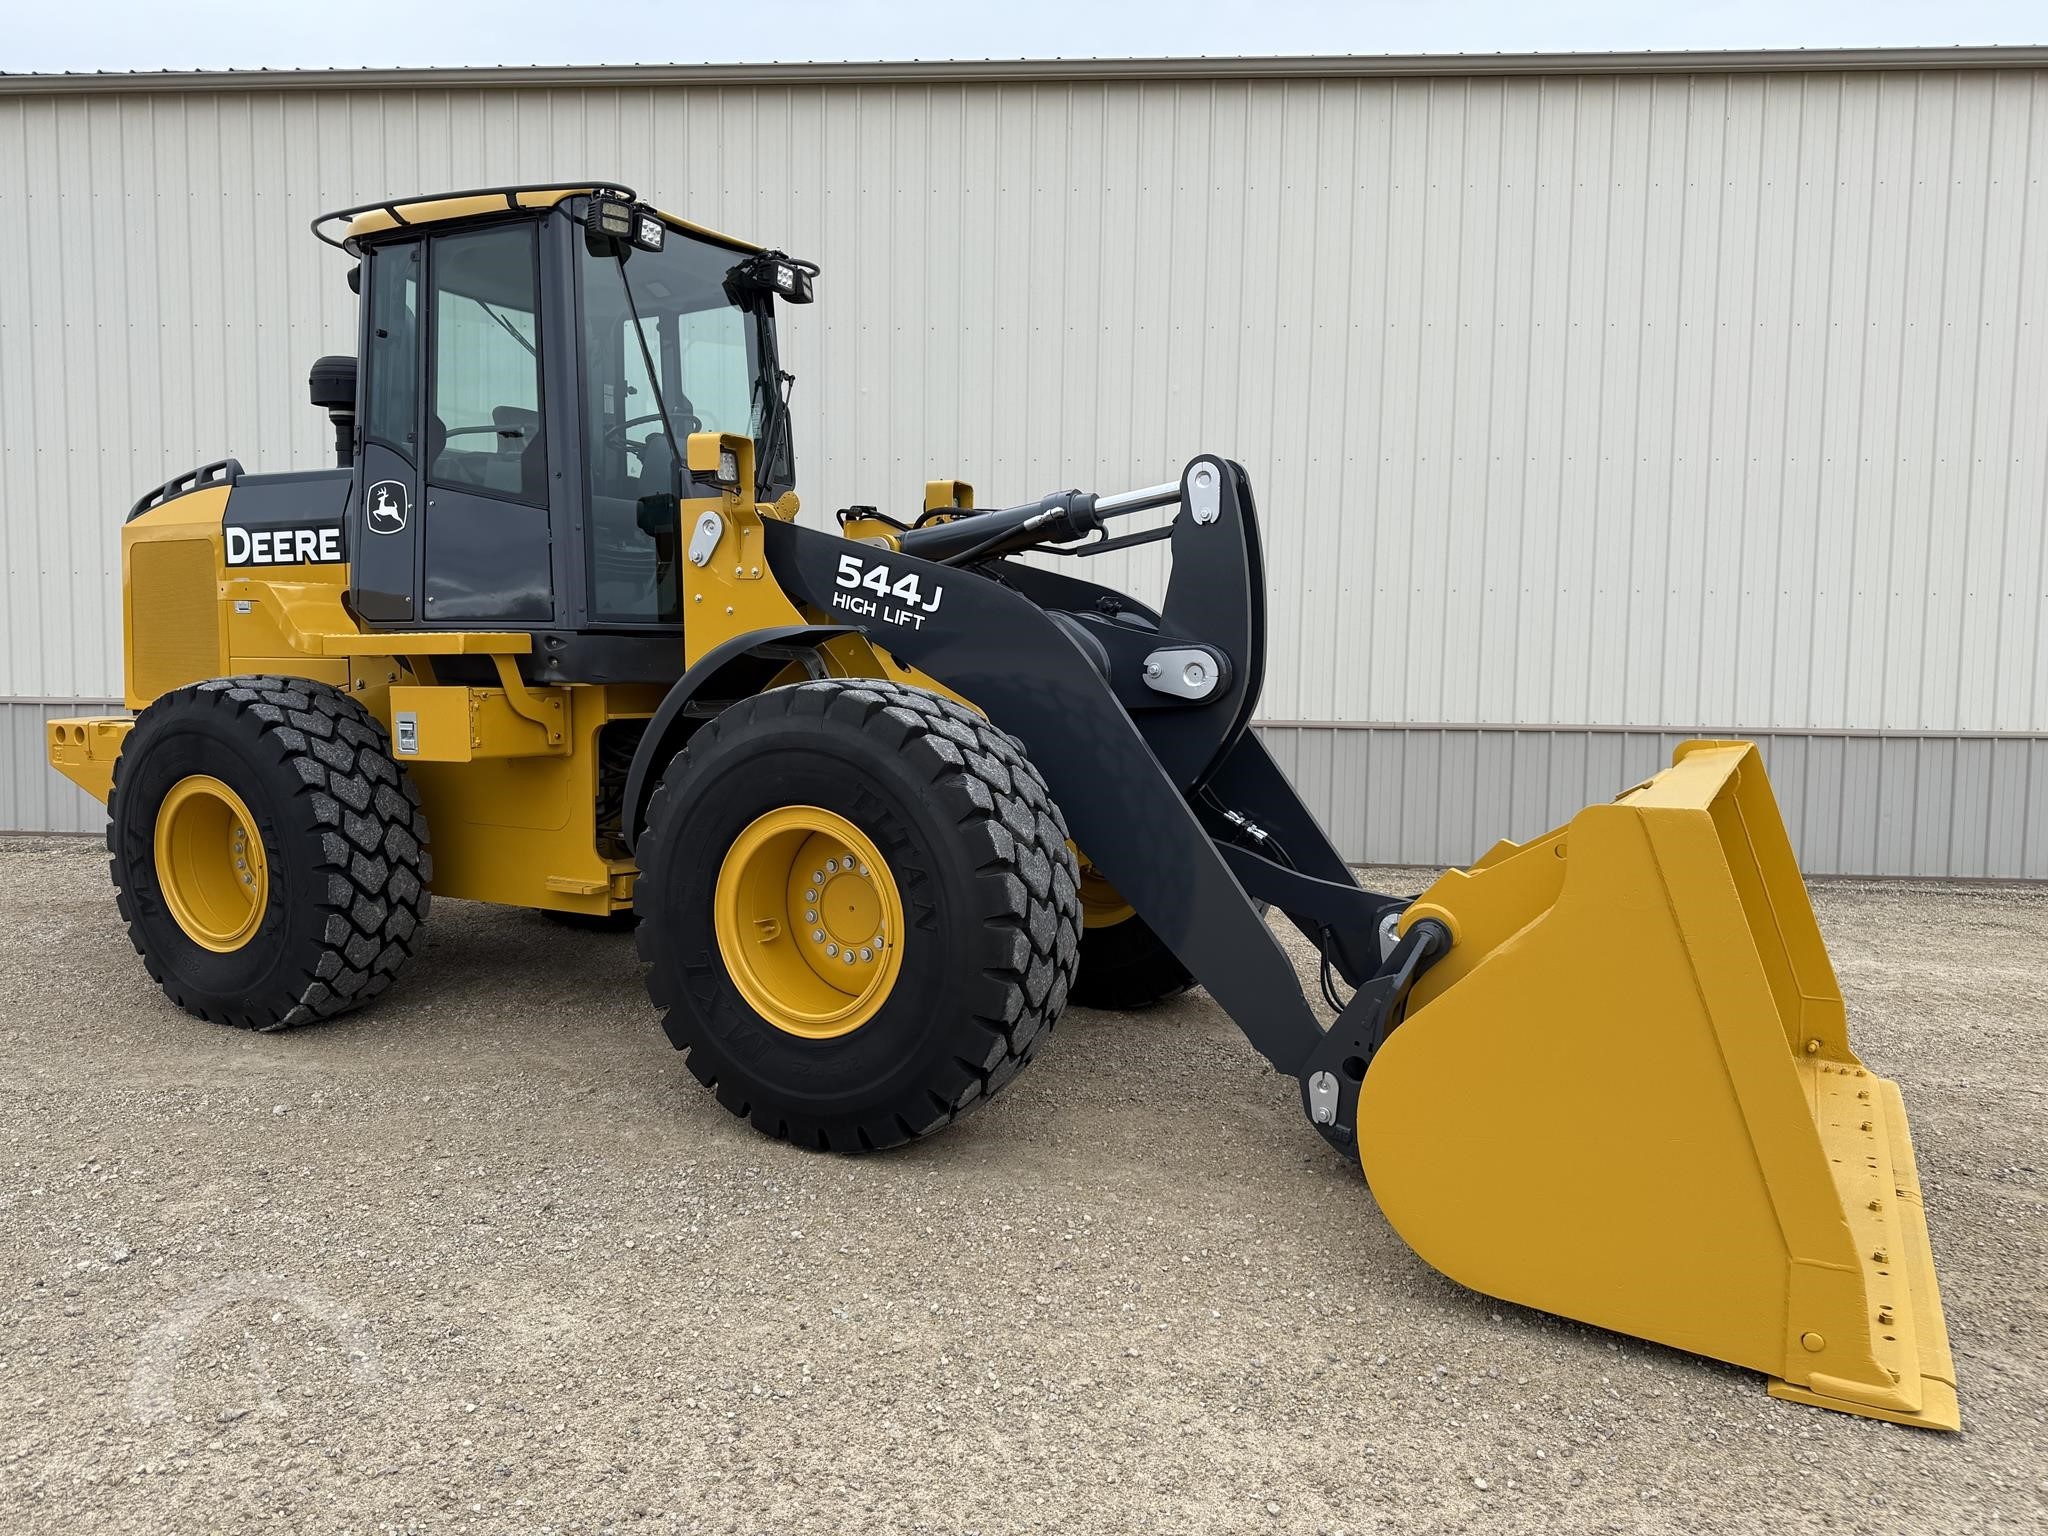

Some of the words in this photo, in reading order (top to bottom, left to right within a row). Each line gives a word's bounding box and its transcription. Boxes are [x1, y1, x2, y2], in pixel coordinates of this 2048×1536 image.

[226, 527, 341, 564] DEERE
[836, 554, 943, 612] 544J
[832, 591, 877, 617] HIGH
[883, 606, 926, 630] LIFT
[850, 781, 939, 935] TITAN
